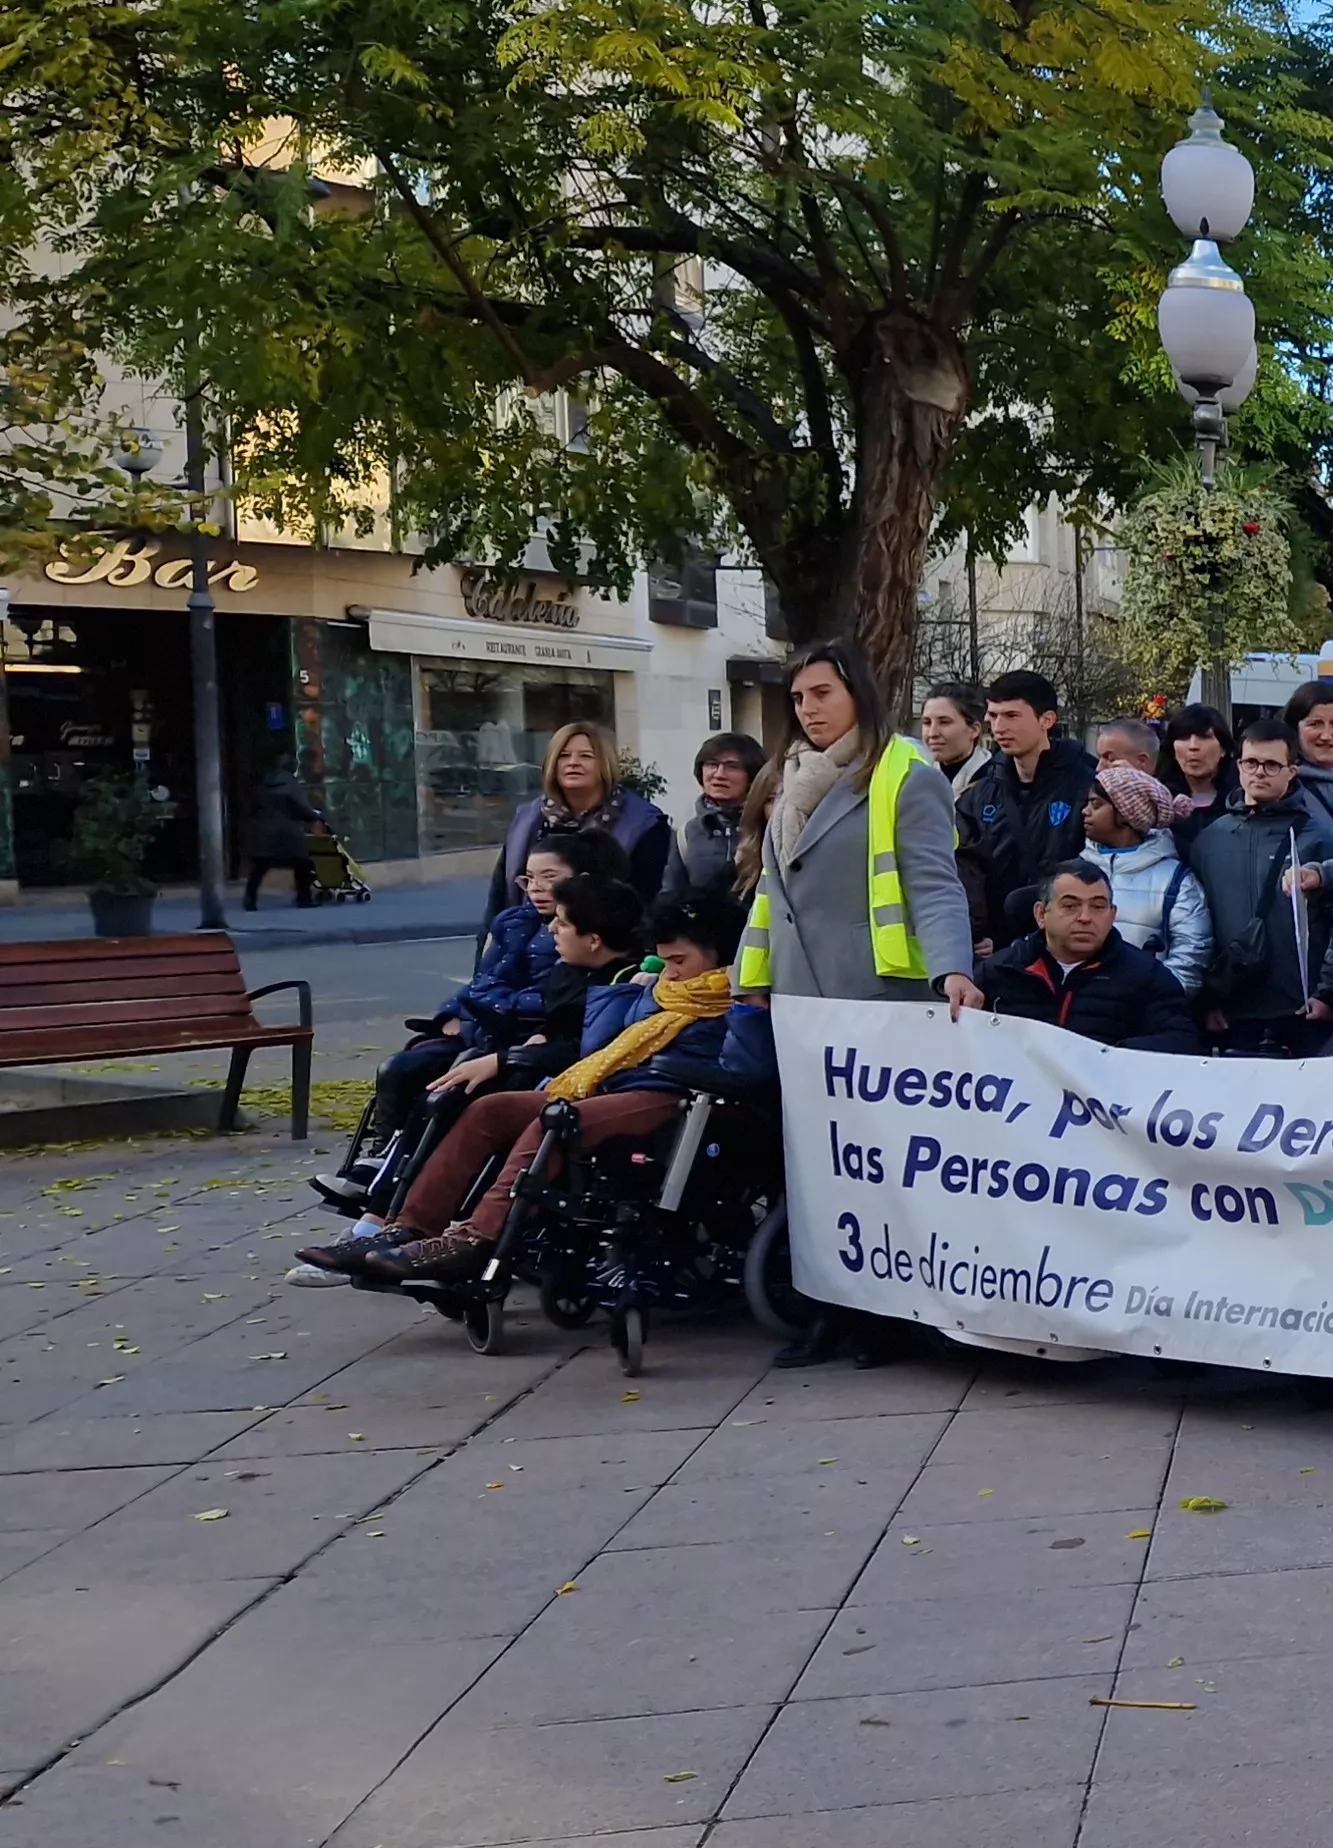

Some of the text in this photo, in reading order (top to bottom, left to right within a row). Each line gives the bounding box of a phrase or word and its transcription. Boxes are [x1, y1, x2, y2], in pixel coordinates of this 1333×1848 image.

[46, 537, 260, 592] Bar
[299, 670, 310, 684] 5
[823, 1046, 1031, 1124] Huesca,
[1049, 1088, 1132, 1138] por
[1146, 1089, 1225, 1150] los
[829, 1120, 884, 1184] las
[902, 1135, 1168, 1217] Personas
[1190, 1182, 1280, 1225] con
[837, 1211, 865, 1272] 3
[870, 1223, 914, 1282] de
[919, 1232, 1114, 1313] diciembre
[1124, 1284, 1174, 1318] Día
